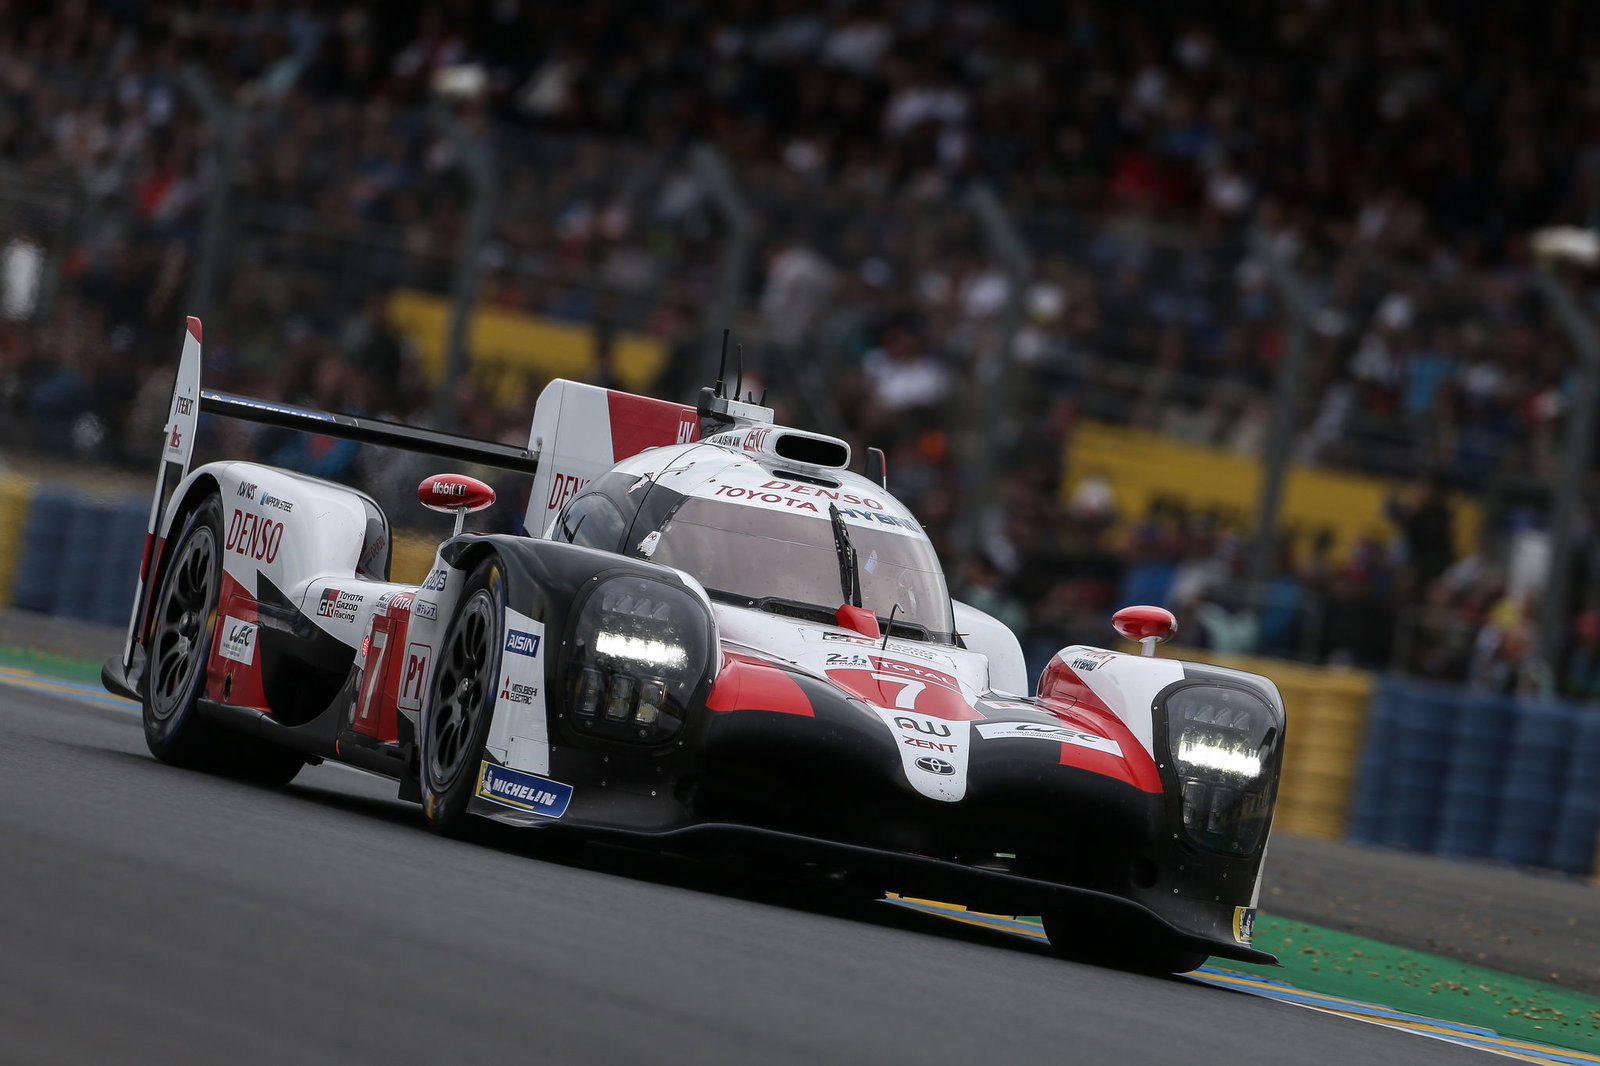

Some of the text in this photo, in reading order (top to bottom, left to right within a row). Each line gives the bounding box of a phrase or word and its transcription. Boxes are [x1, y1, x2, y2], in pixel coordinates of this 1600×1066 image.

[432, 481, 456, 495] Mobil
[548, 472, 591, 511] DEN
[714, 485, 820, 513] TOYOTA
[760, 480, 884, 511] DENSO
[226, 508, 284, 564] DENSO
[340, 591, 364, 602] TOYOTA
[391, 594, 412, 611] TOTA
[333, 610, 355, 623] Racing
[507, 634, 537, 653] AISIN
[361, 631, 389, 719] 7
[402, 654, 426, 700] P1
[874, 659, 958, 689] TOTAL
[510, 692, 533, 705] ELECTRIC
[870, 672, 927, 710] 7
[902, 734, 958, 753] ZENT
[492, 778, 557, 806] MICHELIN
